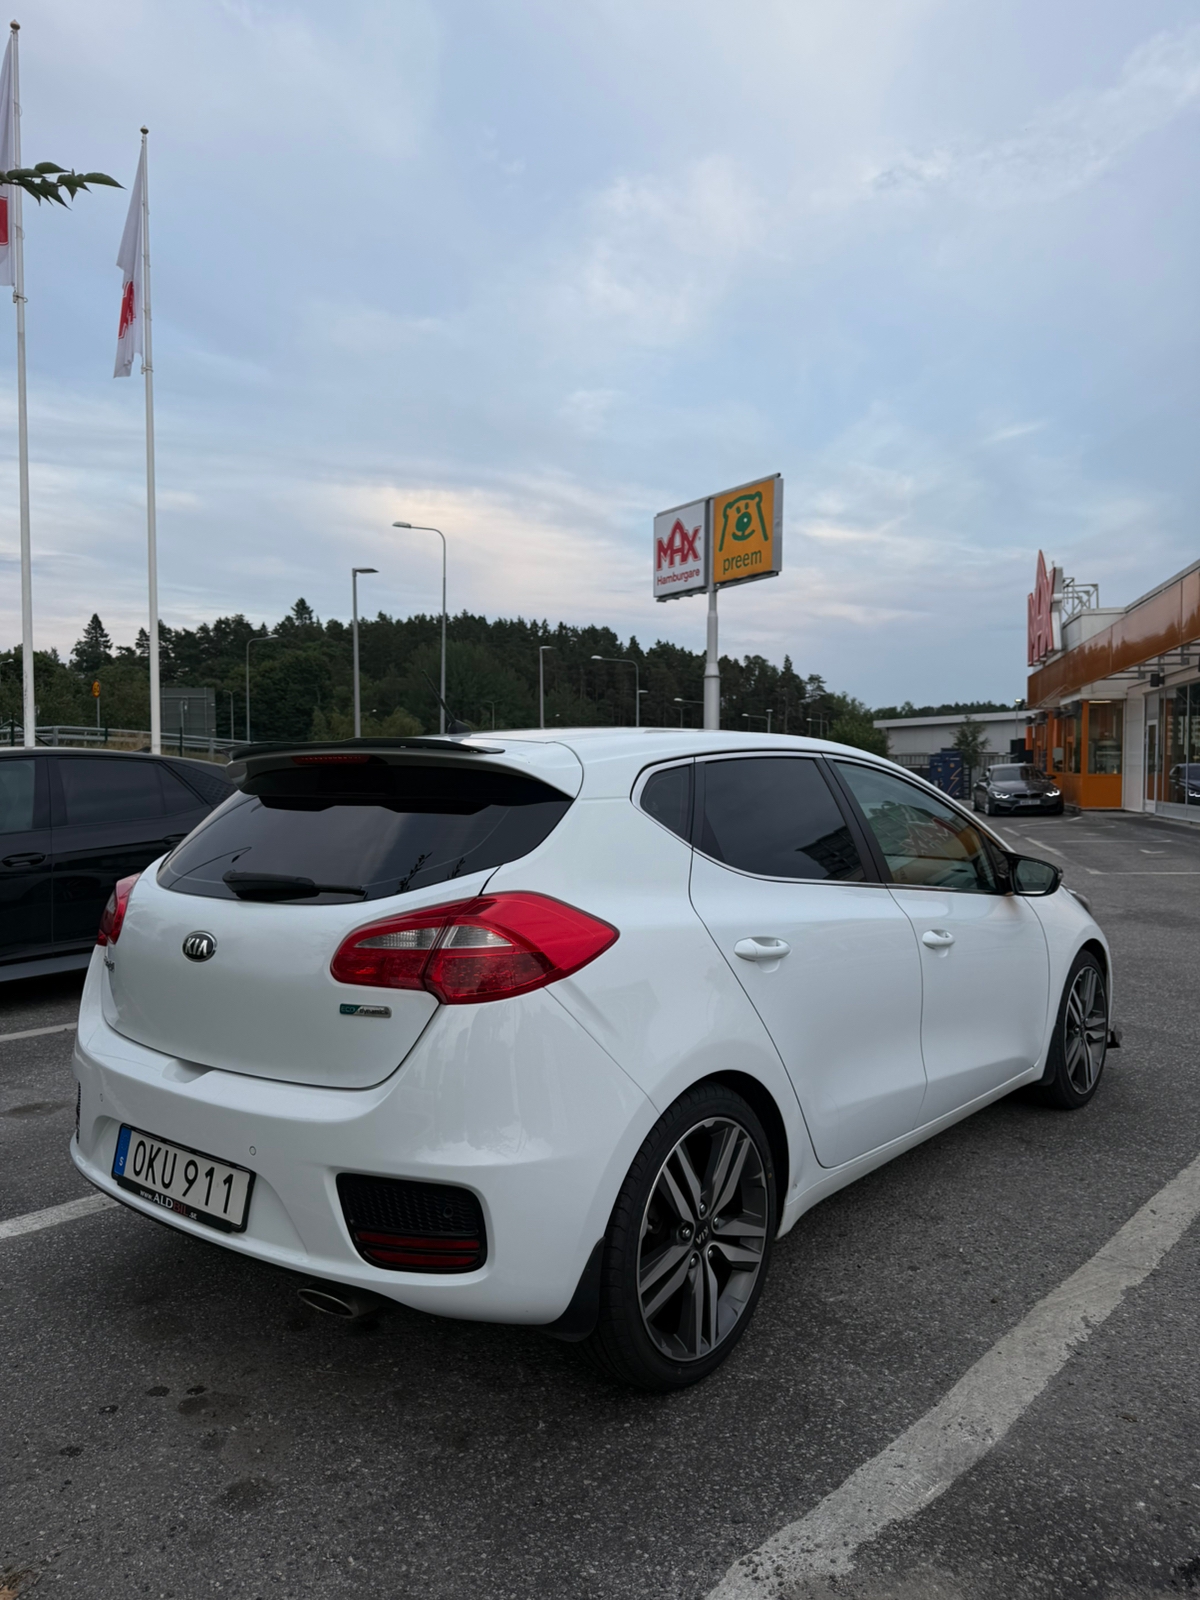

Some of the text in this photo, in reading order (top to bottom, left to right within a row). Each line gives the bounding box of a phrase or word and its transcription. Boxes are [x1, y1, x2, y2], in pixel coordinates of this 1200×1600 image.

[656, 517, 702, 571] MAX
[723, 549, 762, 575] preem
[656, 568, 700, 585] Hamburgare
[1027, 549, 1056, 667] MAX
[185, 937, 208, 956] KIA
[133, 1140, 234, 1214] OKU 911
